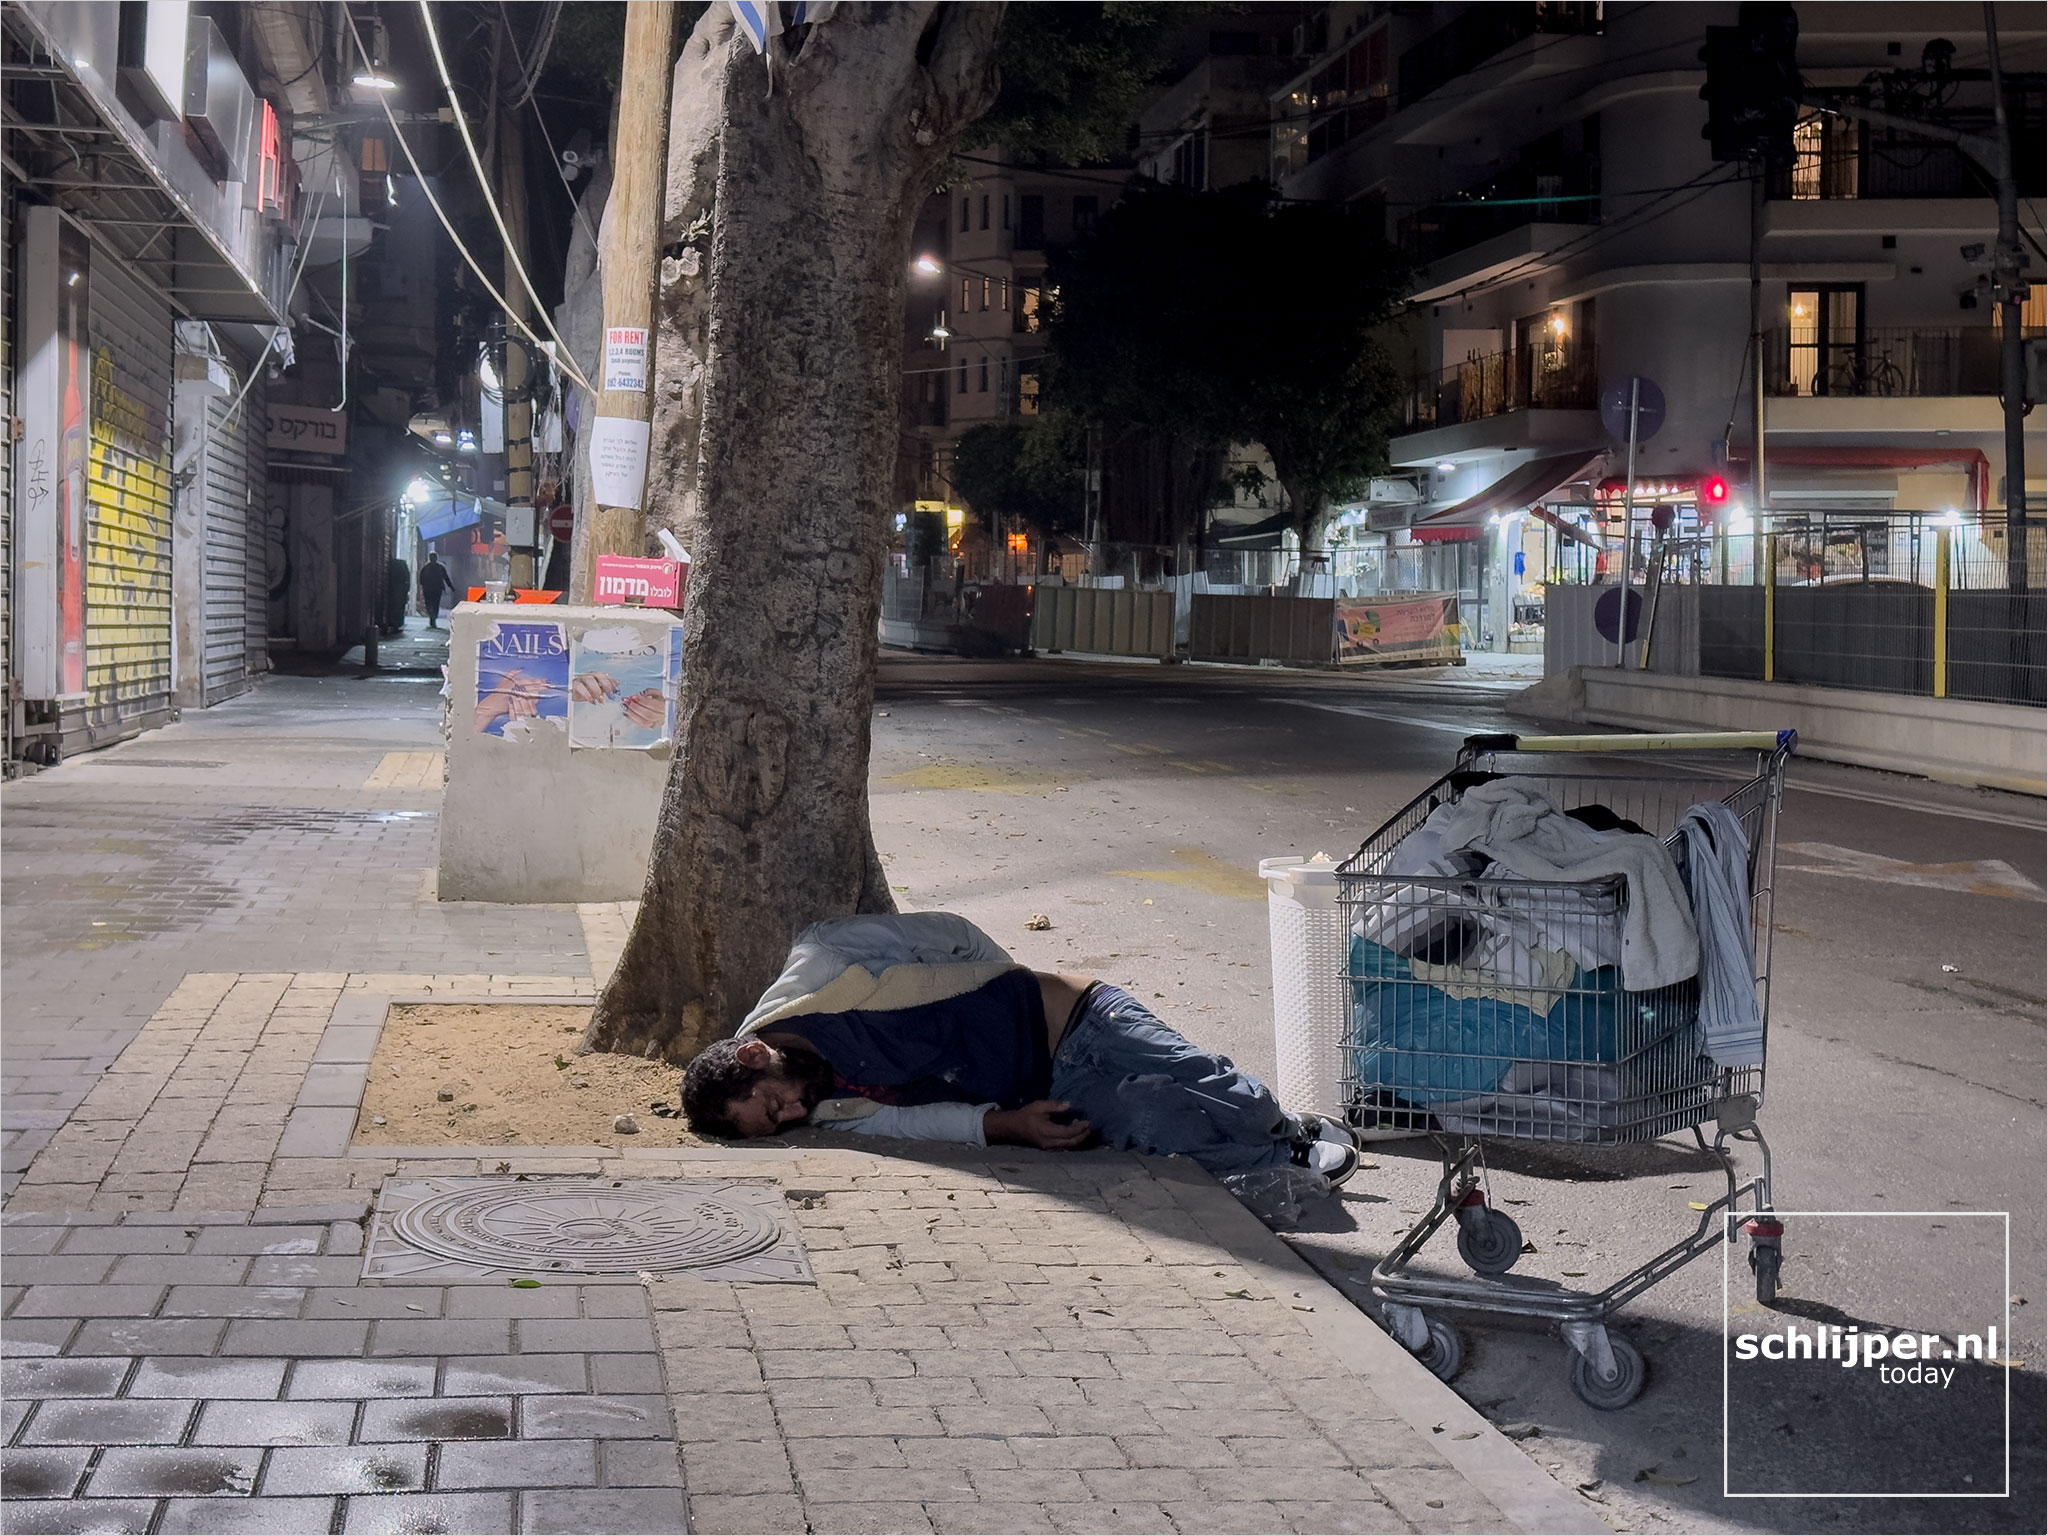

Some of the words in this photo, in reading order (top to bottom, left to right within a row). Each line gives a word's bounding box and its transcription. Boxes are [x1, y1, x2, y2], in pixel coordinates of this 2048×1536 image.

[609, 331, 623, 344] FOR
[624, 331, 645, 345] RENT
[625, 348, 645, 357] ROOMS
[280, 418, 337, 440] בורקס
[488, 633, 563, 656] NAILS
